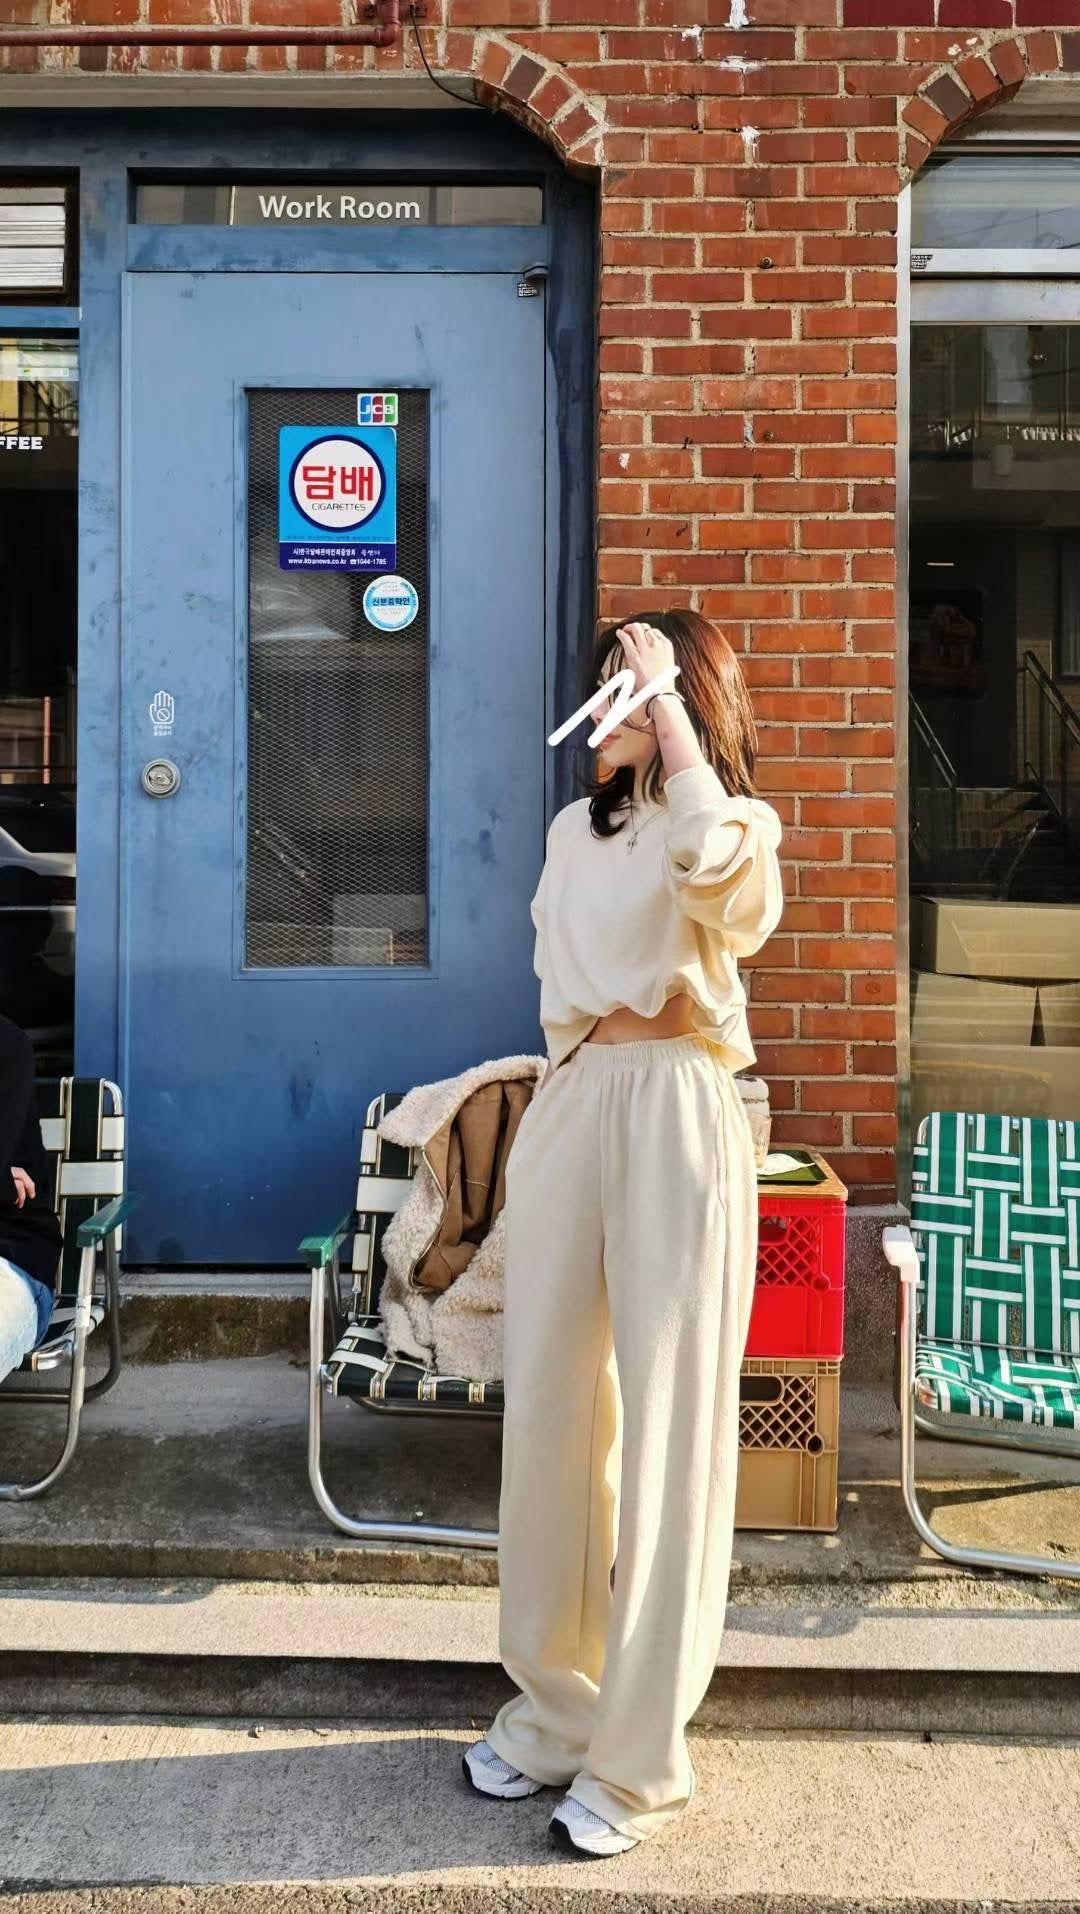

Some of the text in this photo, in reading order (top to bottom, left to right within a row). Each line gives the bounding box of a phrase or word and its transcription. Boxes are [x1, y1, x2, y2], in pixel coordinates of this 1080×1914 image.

[258, 194, 420, 219] Work Room
[302, 465, 373, 501] 담배
[311, 503, 366, 511] CIGARETTES
